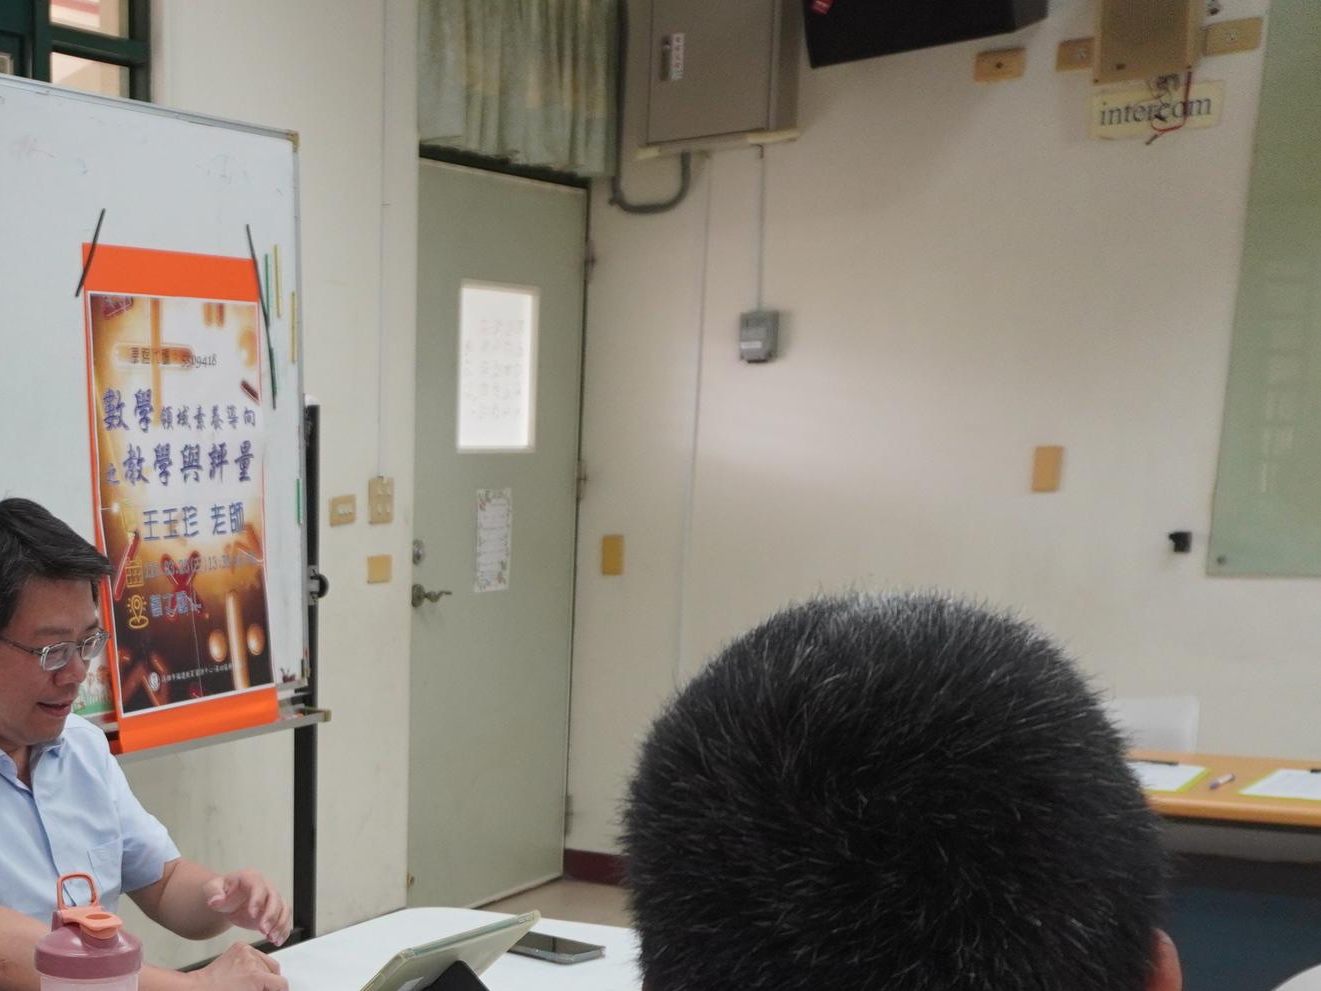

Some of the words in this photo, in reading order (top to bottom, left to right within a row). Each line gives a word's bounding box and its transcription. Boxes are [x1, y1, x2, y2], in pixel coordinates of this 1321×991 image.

[1099, 96, 1212, 126] intercom
[106, 440, 255, 487] 之教學與評量
[210, 501, 246, 536] 老師
